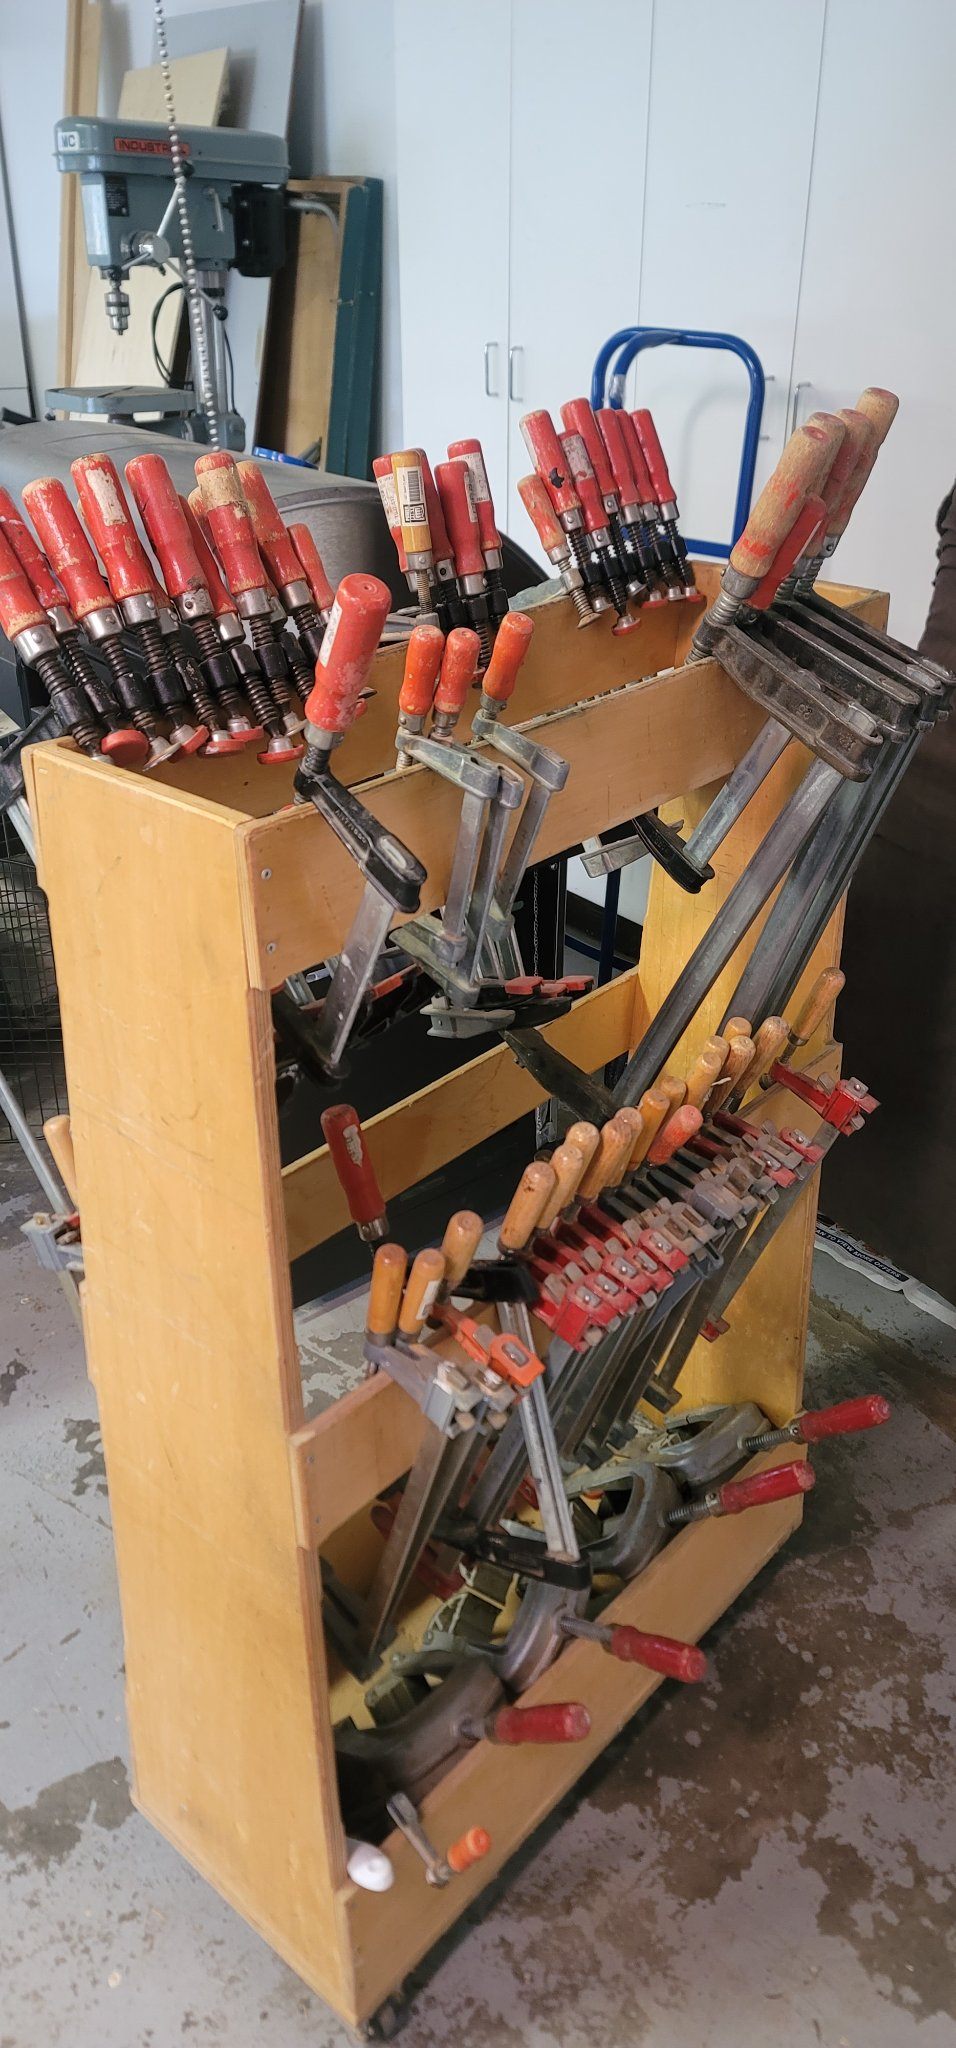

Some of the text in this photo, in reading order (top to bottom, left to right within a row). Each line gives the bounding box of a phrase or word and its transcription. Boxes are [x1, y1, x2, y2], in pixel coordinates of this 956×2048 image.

[837, 1239, 855, 1252] VIEW
[853, 1250, 873, 1263] MORE
[873, 1261, 901, 1278] OFFERS
